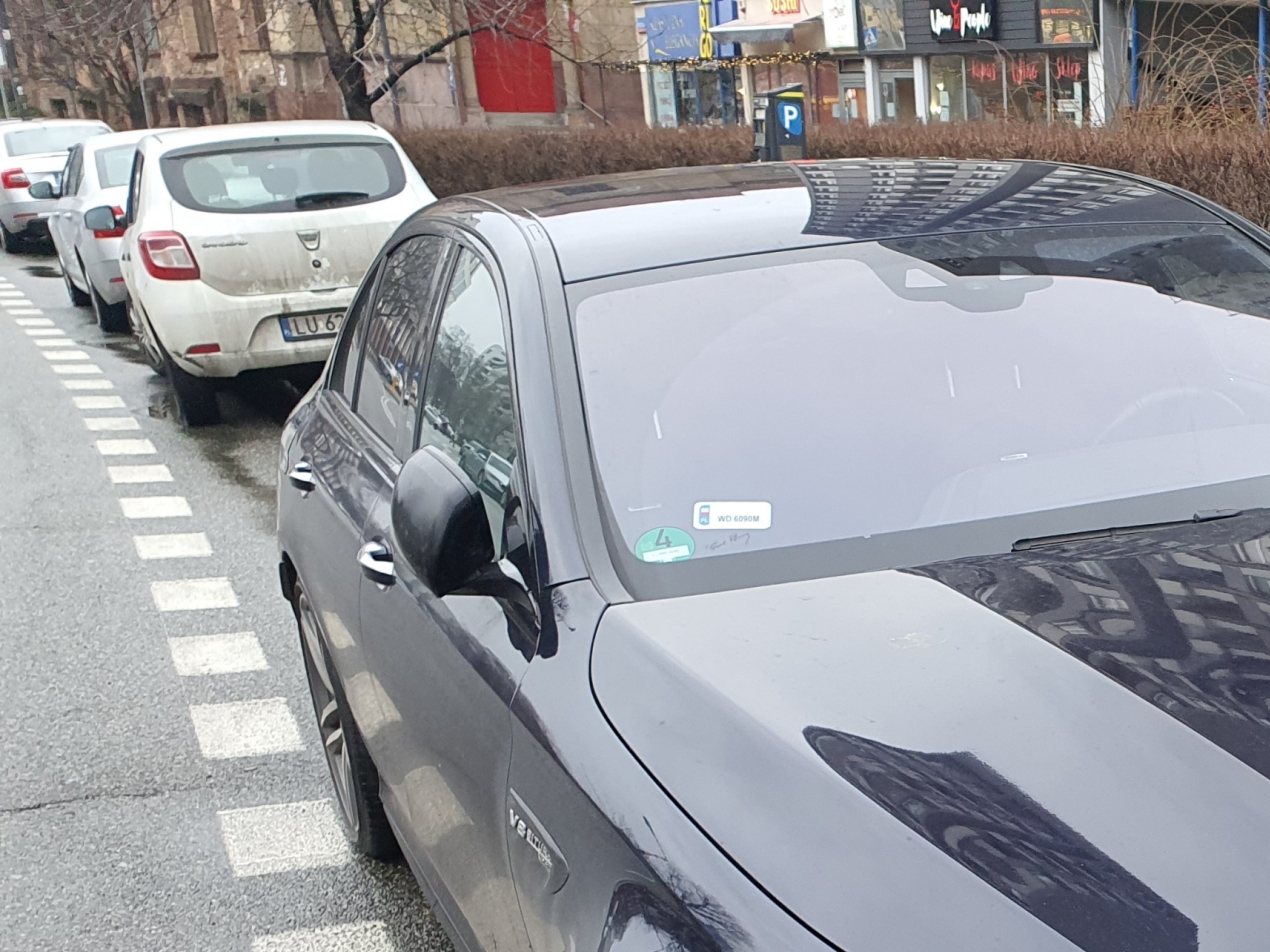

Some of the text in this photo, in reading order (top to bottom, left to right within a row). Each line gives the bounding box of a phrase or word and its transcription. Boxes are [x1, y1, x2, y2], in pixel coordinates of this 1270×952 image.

[784, 105, 798, 129] P
[293, 315, 319, 335] LU
[655, 529, 672, 547] 4
